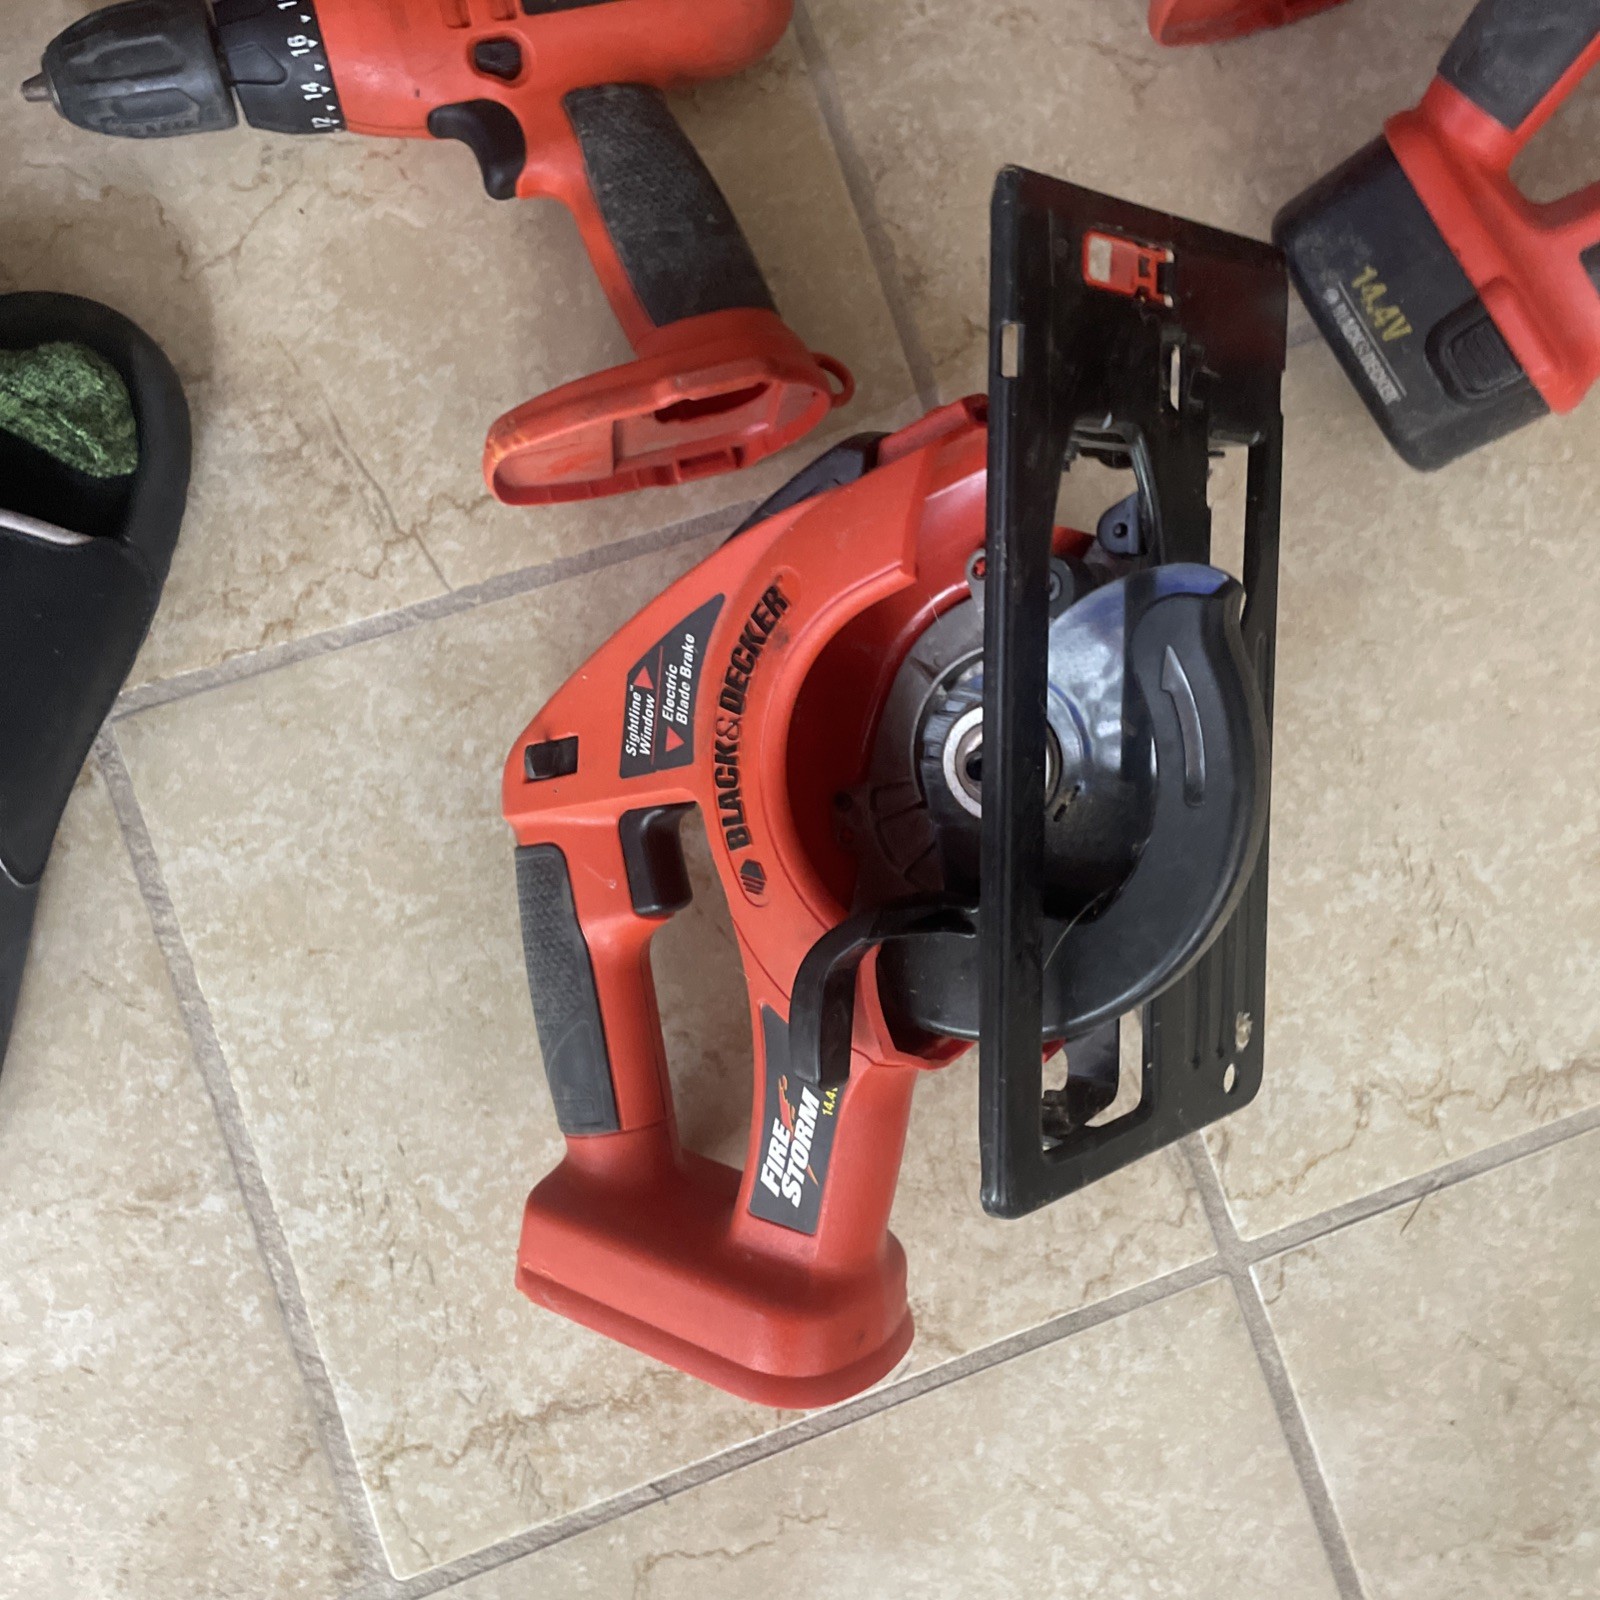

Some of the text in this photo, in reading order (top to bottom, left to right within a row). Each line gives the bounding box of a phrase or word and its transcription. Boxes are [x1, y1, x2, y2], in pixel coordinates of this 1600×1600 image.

[287, 34, 310, 57] 16
[300, 82, 323, 100] 14
[1351, 265, 1413, 342] 14.4V
[662, 663, 678, 723] Electric
[675, 633, 696, 726] Blade Brake
[639, 693, 656, 756] Window
[760, 1117, 791, 1198] FIRE
[781, 1085, 820, 1208] STORM
